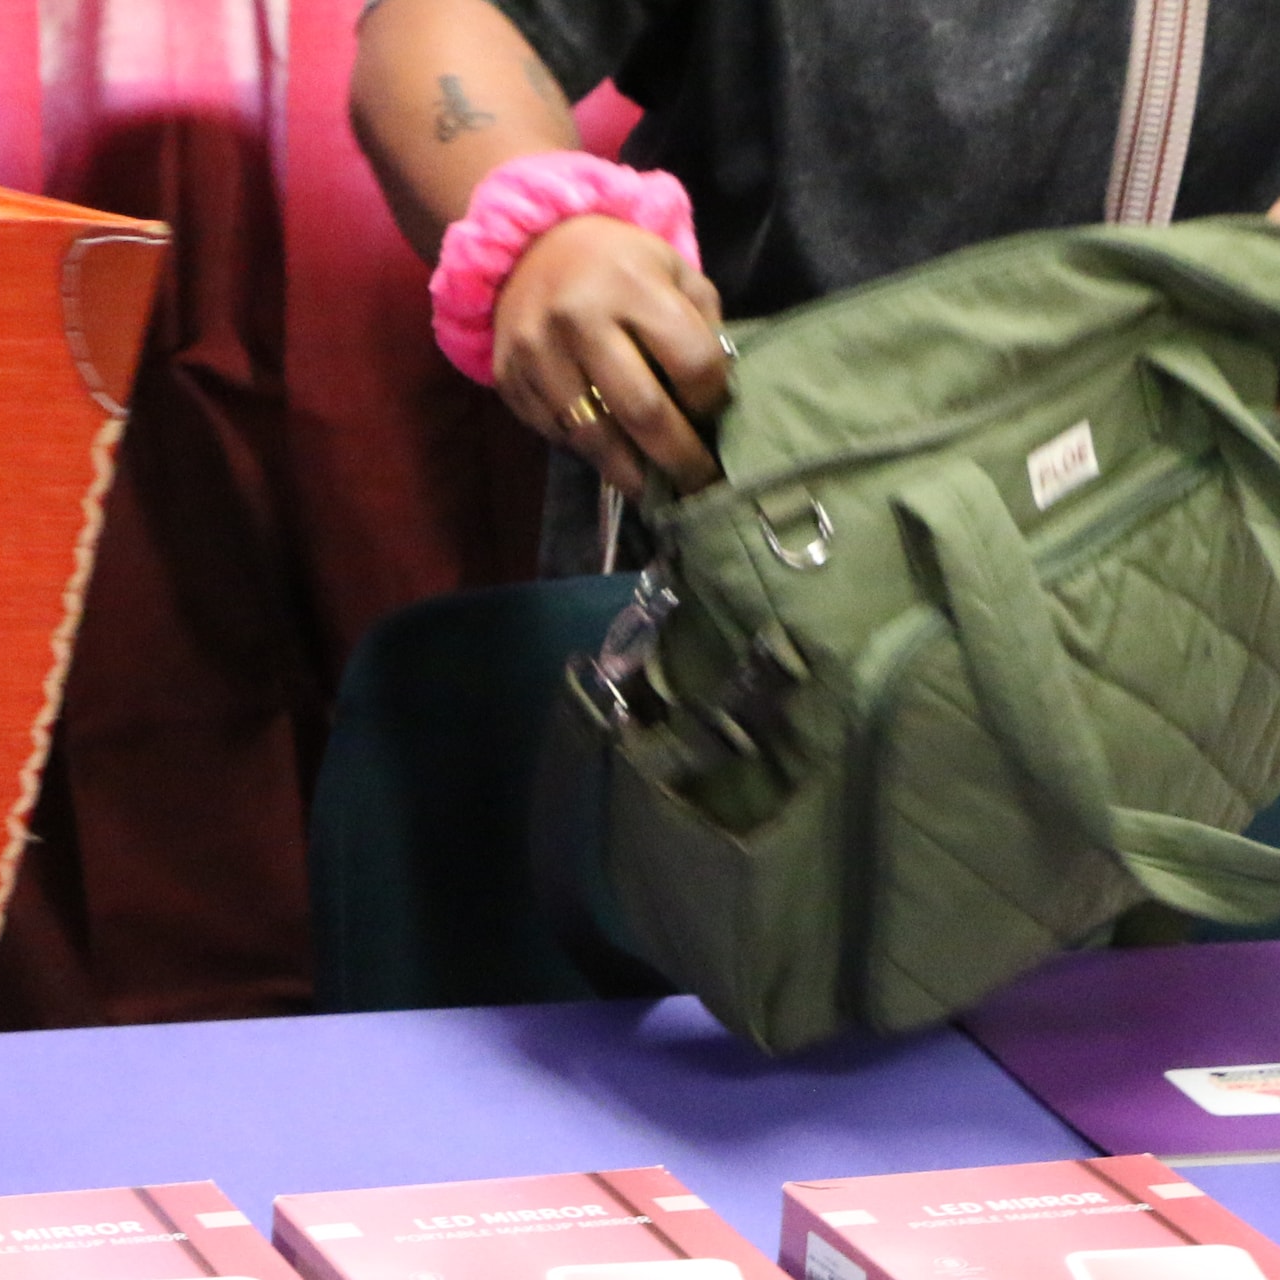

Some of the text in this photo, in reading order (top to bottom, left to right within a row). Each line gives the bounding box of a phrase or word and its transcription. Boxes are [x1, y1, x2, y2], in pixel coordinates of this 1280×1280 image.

[922, 1191, 1109, 1217] LED MIRROR
[413, 1204, 608, 1230] LED MIRROR
[10, 1220, 145, 1241] MIRROR
[394, 1229, 493, 1244] PORTABLE
[495, 1223, 574, 1236] MAKEUP
[23, 1239, 108, 1253] MAKEUP
[111, 1232, 189, 1247] MIRROR
